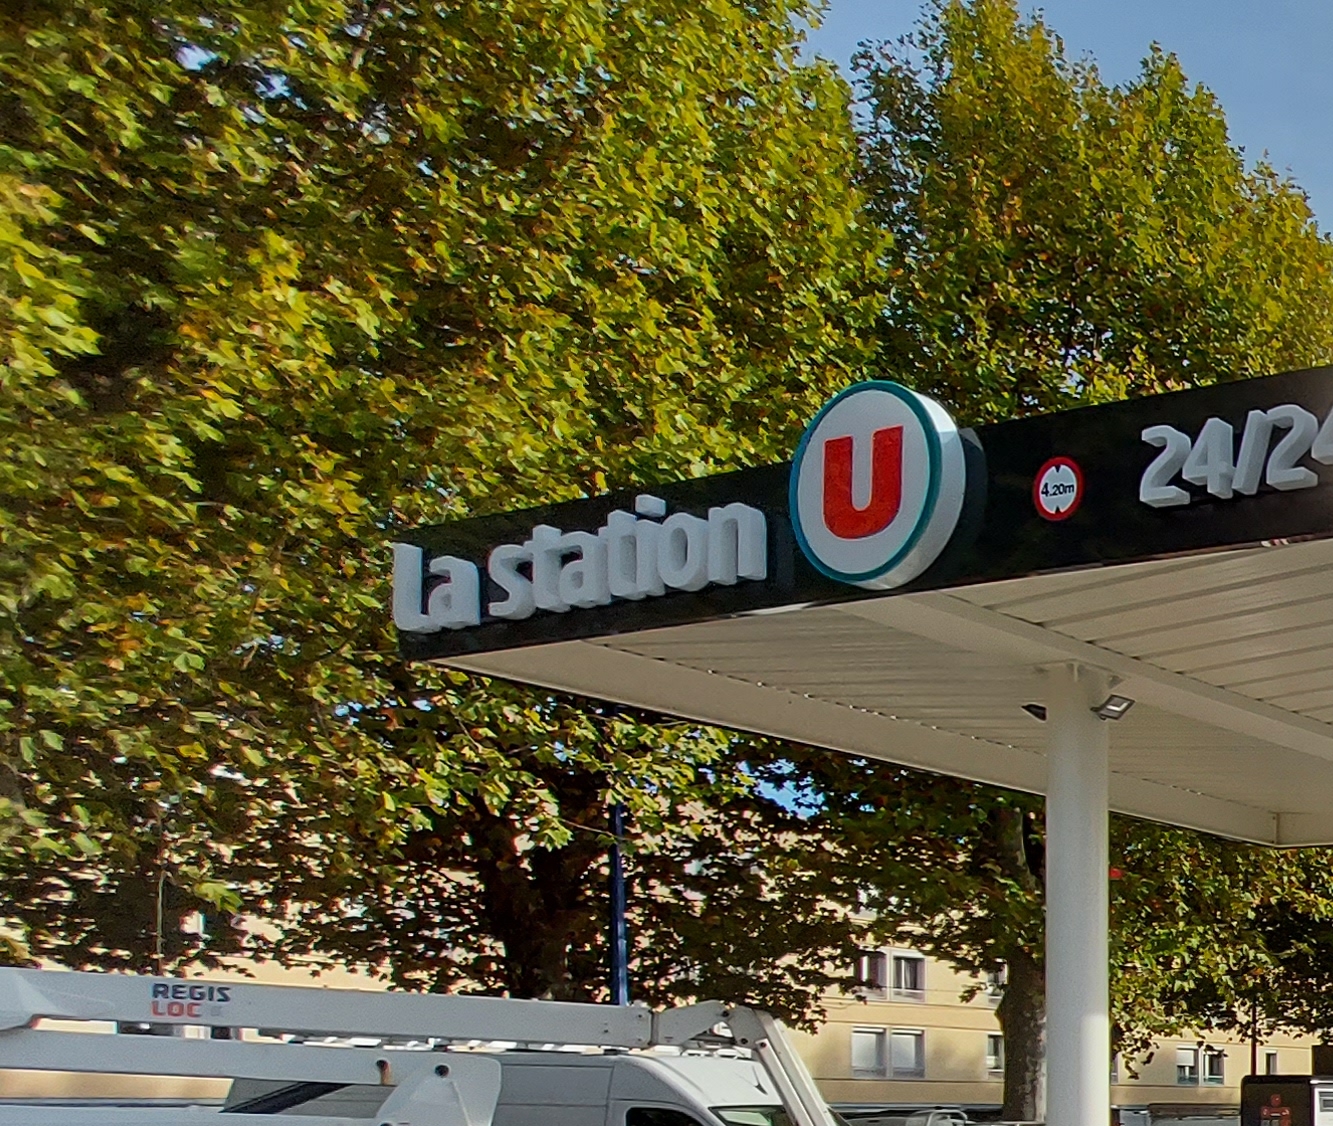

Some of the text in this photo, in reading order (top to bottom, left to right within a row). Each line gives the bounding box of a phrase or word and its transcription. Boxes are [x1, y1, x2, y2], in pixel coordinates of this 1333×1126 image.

[1041, 482, 1075, 498] 4.20m
[487, 494, 767, 621] station
[823, 424, 904, 540] U
[152, 983, 232, 1003] REGIS
[151, 1000, 202, 1018] LOC
